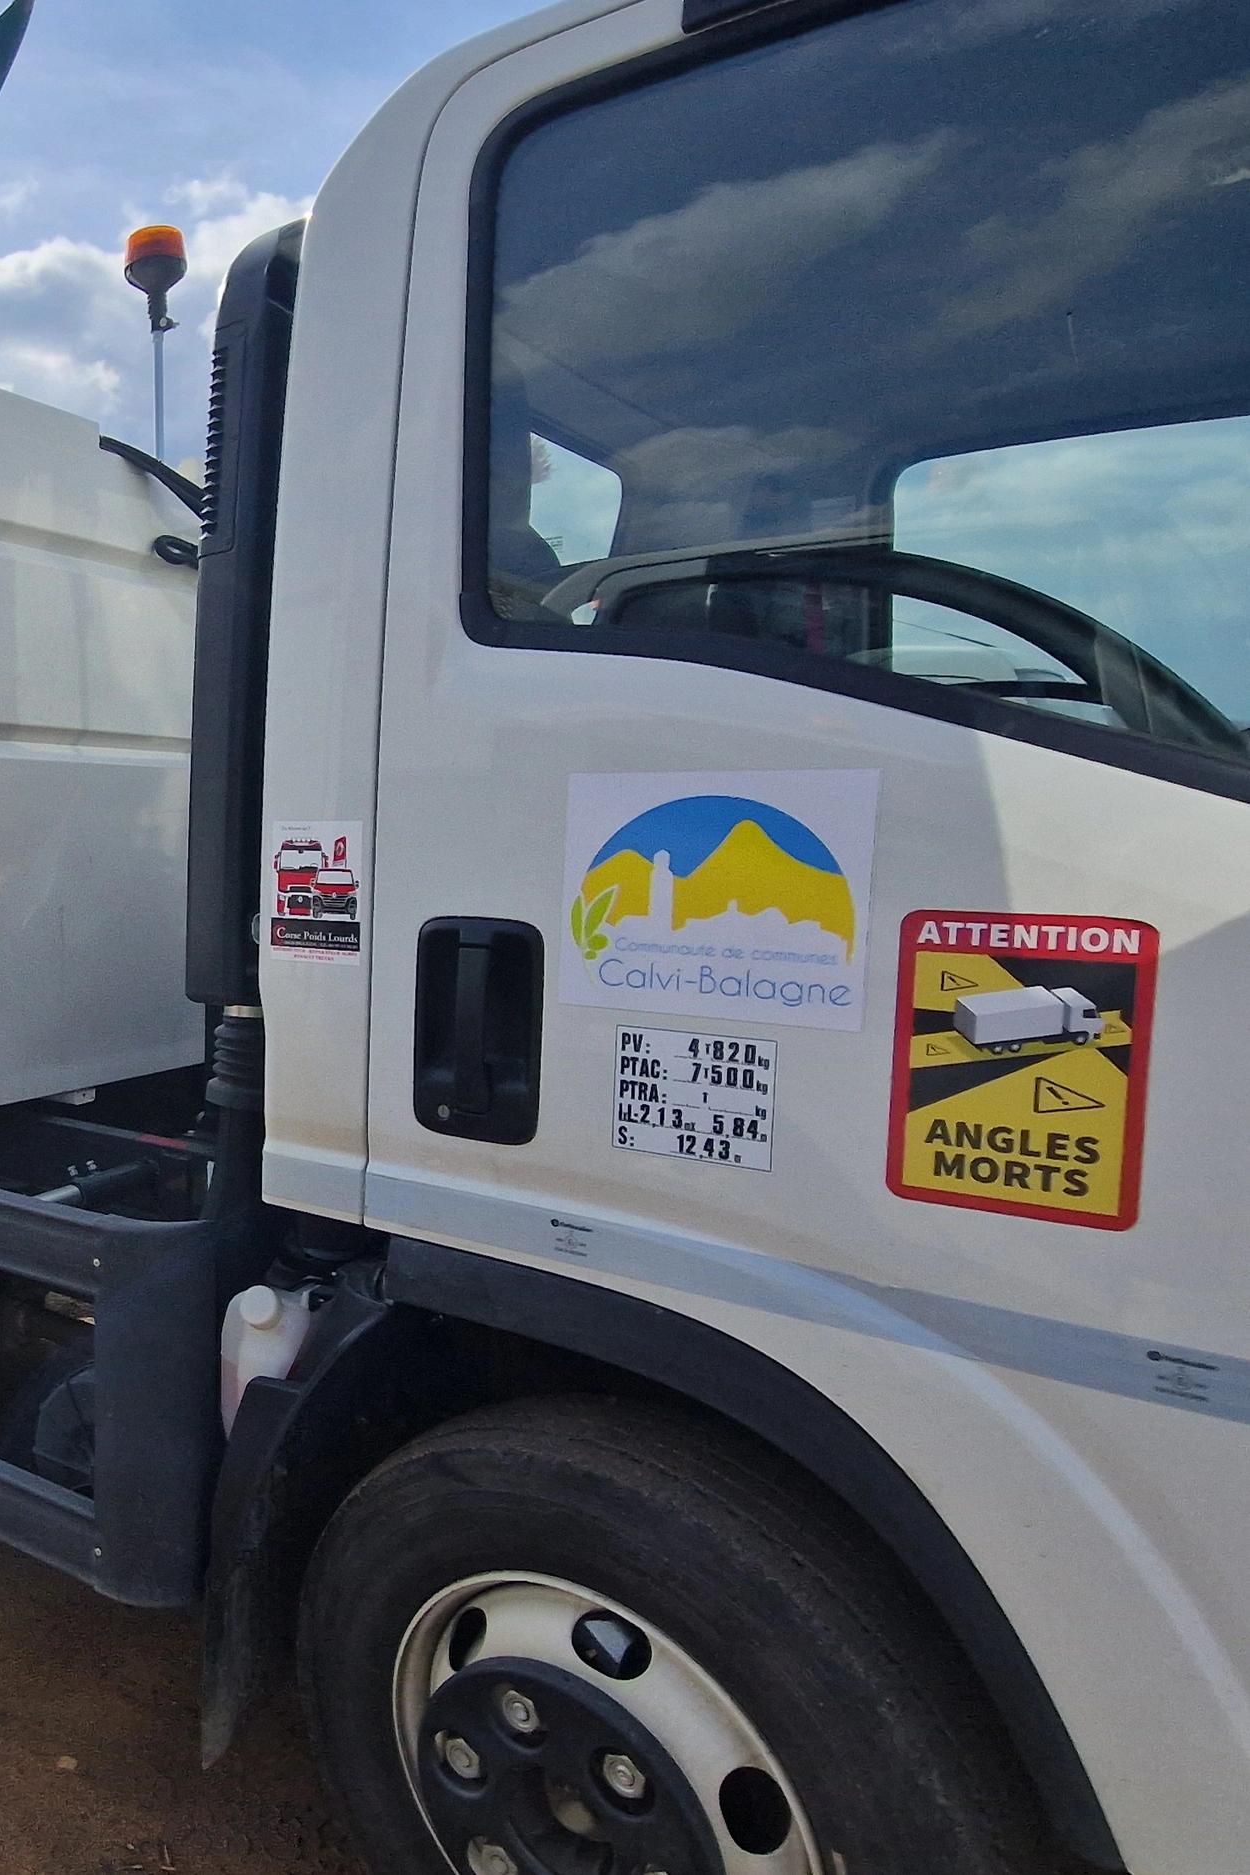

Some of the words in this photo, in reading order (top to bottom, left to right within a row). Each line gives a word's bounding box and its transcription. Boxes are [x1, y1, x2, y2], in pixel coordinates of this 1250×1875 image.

[328, 933, 358, 944] Lourds
[916, 920, 1140, 954] ATTENTION
[721, 947, 744, 960] de
[751, 949, 839, 966] communes
[599, 958, 852, 1007] Calvi-Balagne
[621, 1032, 650, 1054] PV:
[620, 1056, 667, 1080] PTAC:
[619, 1079, 667, 1104] PTRA:
[618, 1126, 634, 1147] S:
[925, 1119, 1100, 1164] ANGLES
[933, 1151, 1089, 1196] MORTS
